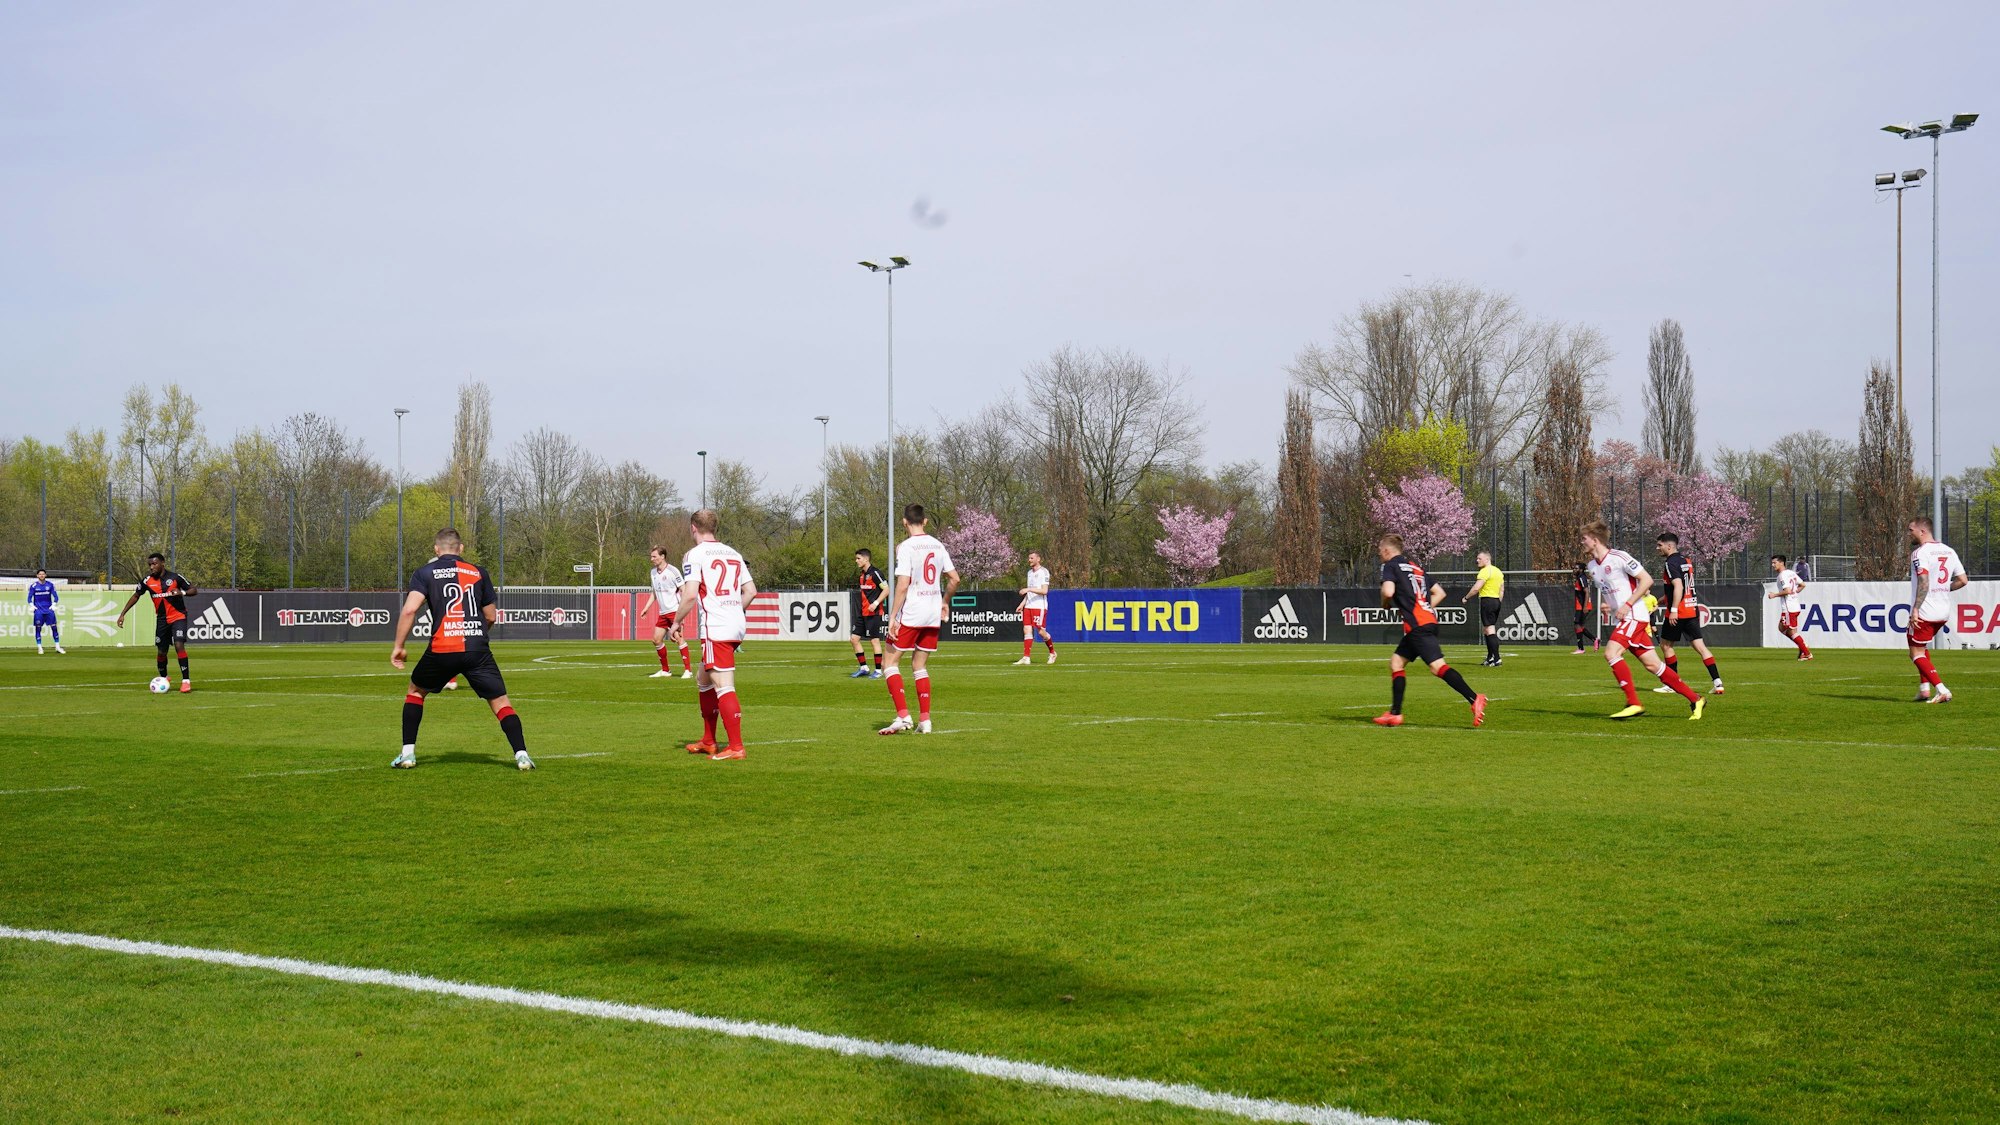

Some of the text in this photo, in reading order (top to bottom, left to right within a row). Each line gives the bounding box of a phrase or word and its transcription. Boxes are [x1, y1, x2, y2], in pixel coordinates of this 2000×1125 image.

[711, 559, 742, 597] 27
[923, 552, 937, 585] 6
[1937, 557, 1949, 584] 3
[443, 583, 479, 618] 21
[790, 601, 840, 633] F95
[951, 611, 1023, 622] Hewlett Packard
[1075, 601, 1199, 631] METRO
[187, 624, 244, 640] adidas
[443, 629, 484, 637] WORKWEAR
[951, 624, 995, 636] Enterprise
[1254, 622, 1308, 639] adidas
[1497, 622, 1559, 641] adidas
